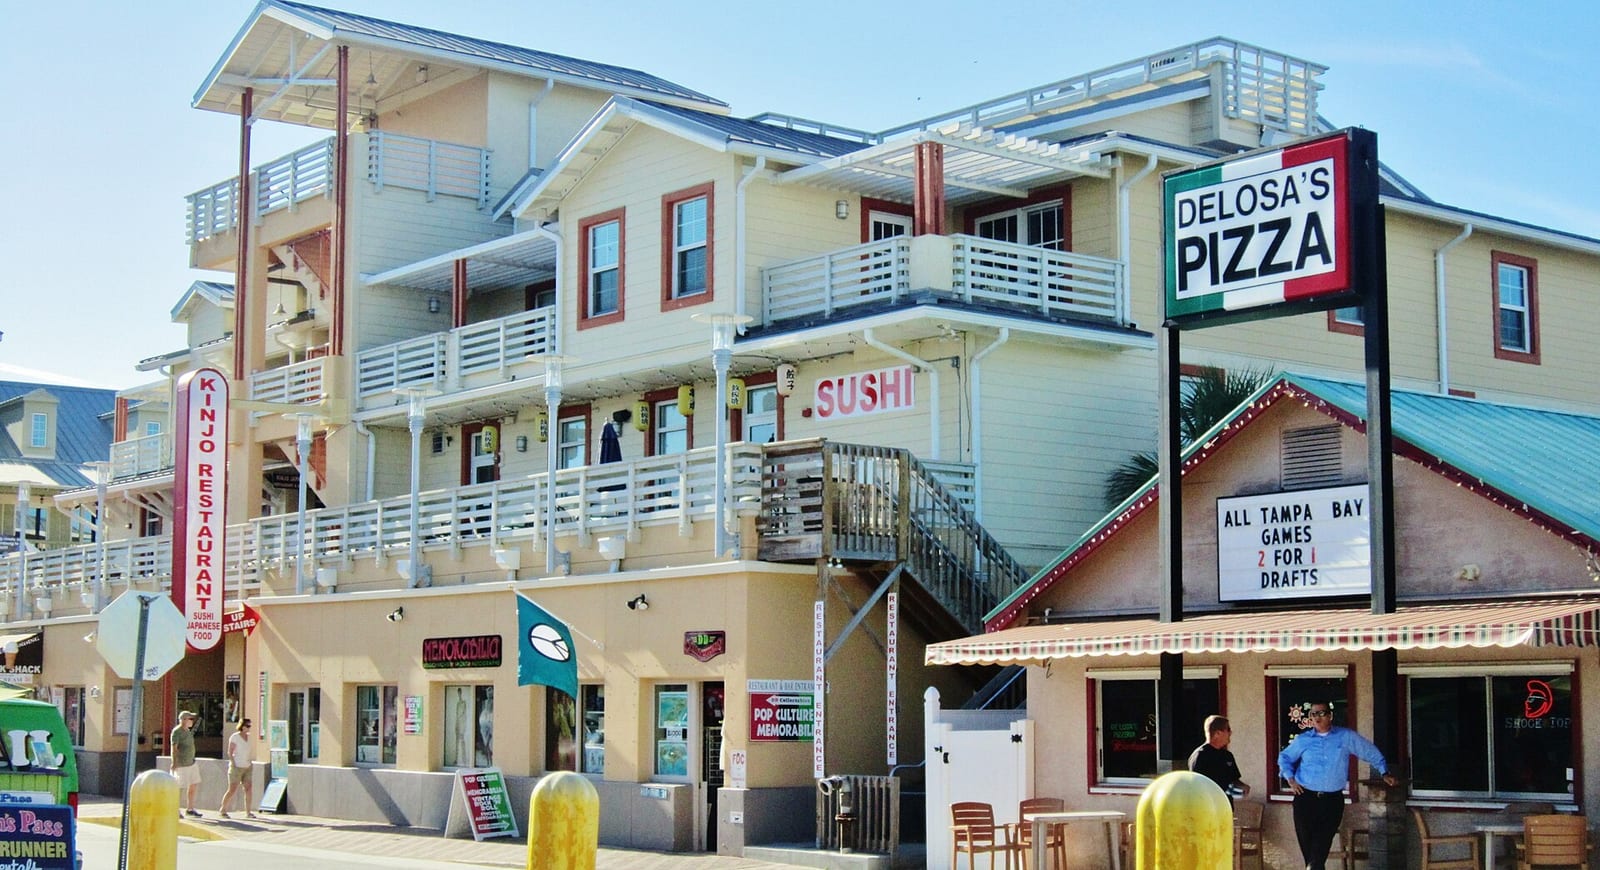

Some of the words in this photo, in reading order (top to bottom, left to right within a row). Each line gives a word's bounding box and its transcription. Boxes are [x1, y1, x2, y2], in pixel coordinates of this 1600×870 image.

[1178, 167, 1330, 229] DELOSA'S
[1177, 211, 1332, 292] PIZZA
[817, 368, 912, 418] SUSHI
[199, 377, 216, 453] KINJO
[1224, 509, 1251, 527] ALL
[1260, 503, 1313, 524] TAMPA
[1332, 498, 1363, 518] BAY
[196, 463, 213, 609] RESTAURANT
[1261, 525, 1312, 545] GAMES
[1258, 550, 1265, 567] 2
[1274, 548, 1303, 566] FOR
[1261, 568, 1318, 588] DRAFTS
[187, 621, 220, 630] JAPANESE
[193, 612, 214, 620] SUSHI
[223, 618, 256, 632] STAIRS
[231, 613, 245, 621] UP
[193, 632, 212, 640] FOOD
[754, 708, 773, 721] POP
[776, 708, 814, 721] CULTURE
[757, 723, 814, 737] MEMORABILI
[19, 810, 63, 837] Pass
[0, 841, 67, 858] RUNNER
